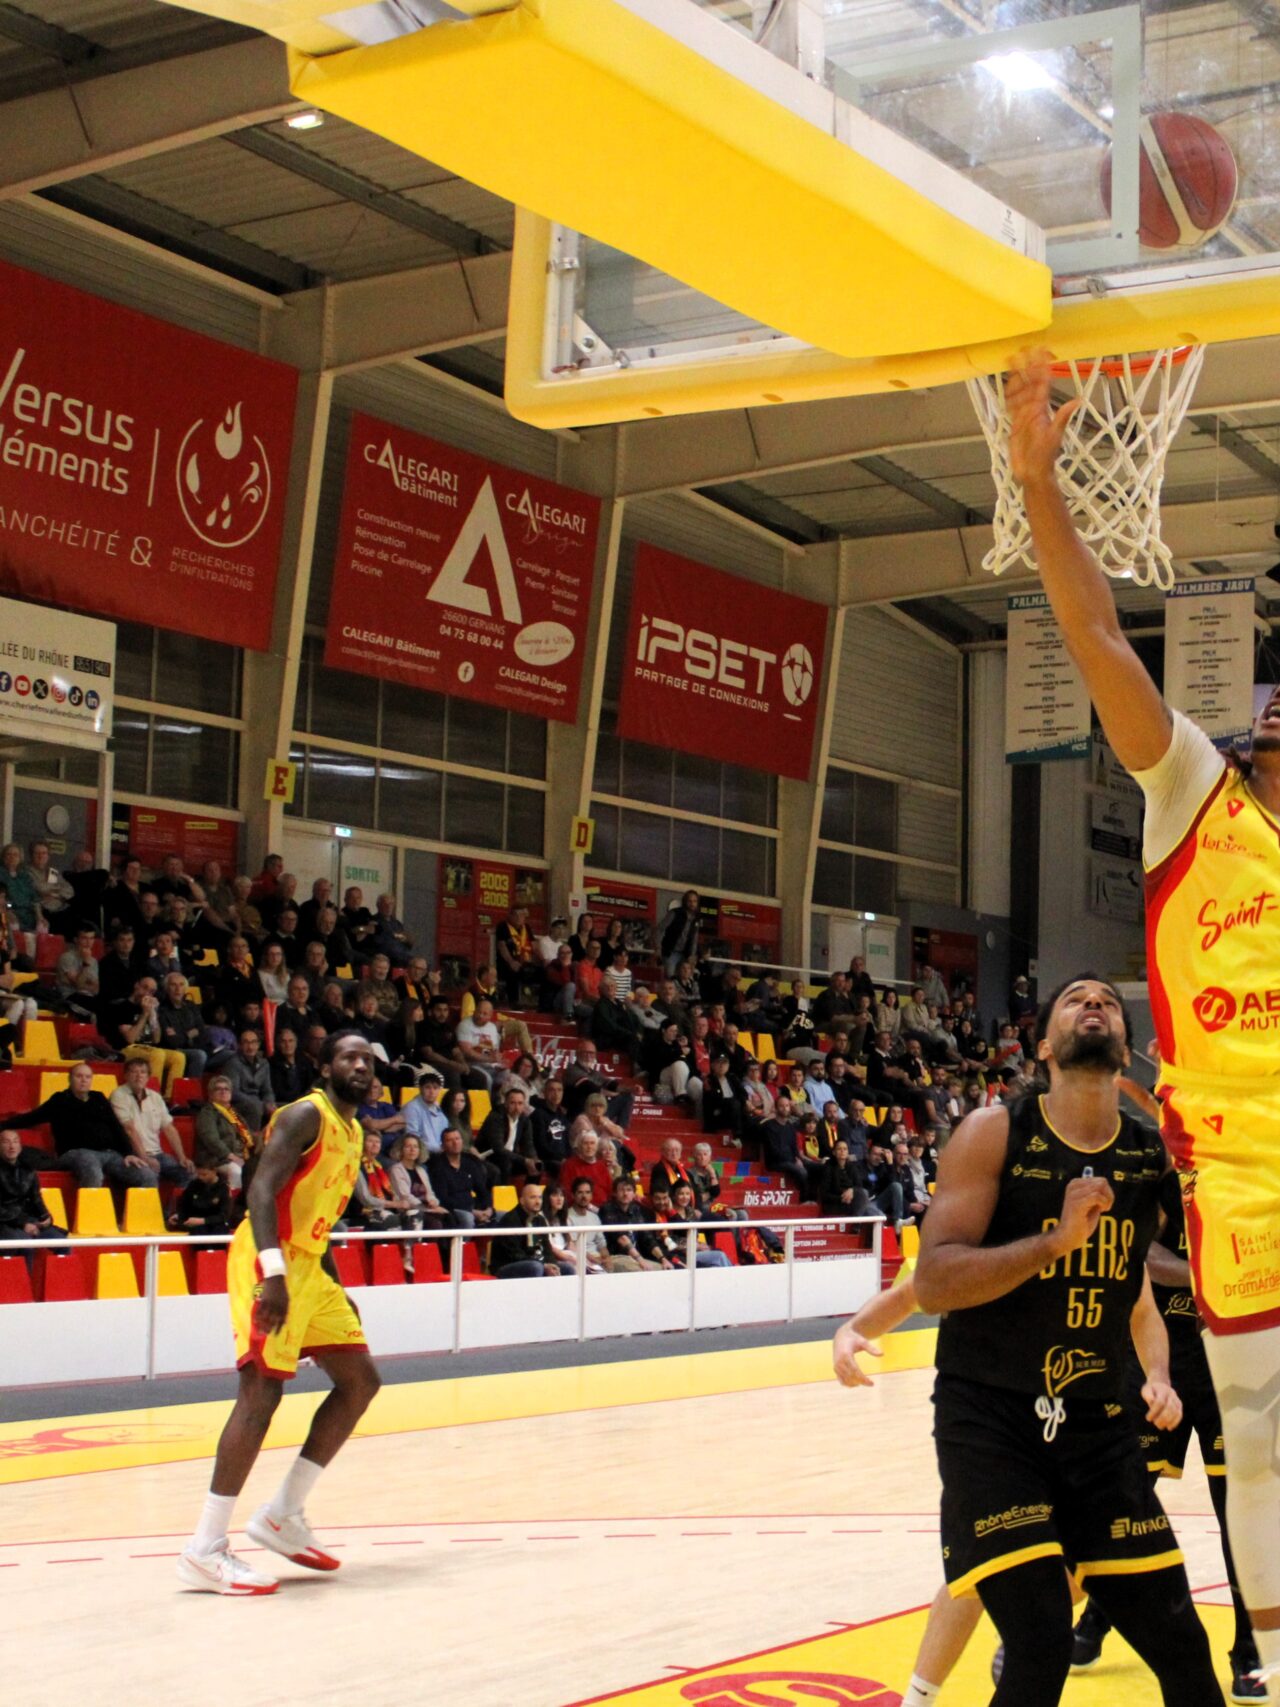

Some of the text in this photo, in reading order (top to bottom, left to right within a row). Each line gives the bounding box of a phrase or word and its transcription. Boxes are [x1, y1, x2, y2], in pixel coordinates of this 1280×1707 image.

[364, 438, 459, 492] CALEGARI
[400, 475, 458, 508] Bâtiment
[357, 508, 441, 543] Construction neuve
[505, 487, 586, 535] CALEGARI
[354, 525, 407, 549] Rénovation
[172, 546, 255, 578] RECHERCHES
[351, 560, 383, 577] Piscine
[353, 543, 376, 558] Pose
[391, 554, 432, 575] Carrelage
[169, 561, 253, 592] D'INFILTRATIONS
[342, 626, 441, 660] CALEGARI Bâtiment
[454, 627, 464, 640] 75
[22, 645, 35, 661] DU
[499, 666, 540, 685] CALEGARI
[634, 667, 769, 713] PARTAGE DE CONNEXIONS
[272, 765, 290, 795] E
[576, 821, 590, 848] D
[345, 865, 381, 884] SORTIE
[480, 872, 509, 891] 2003
[1238, 1230, 1272, 1247] SAINT
[1066, 1287, 1104, 1329] 55
